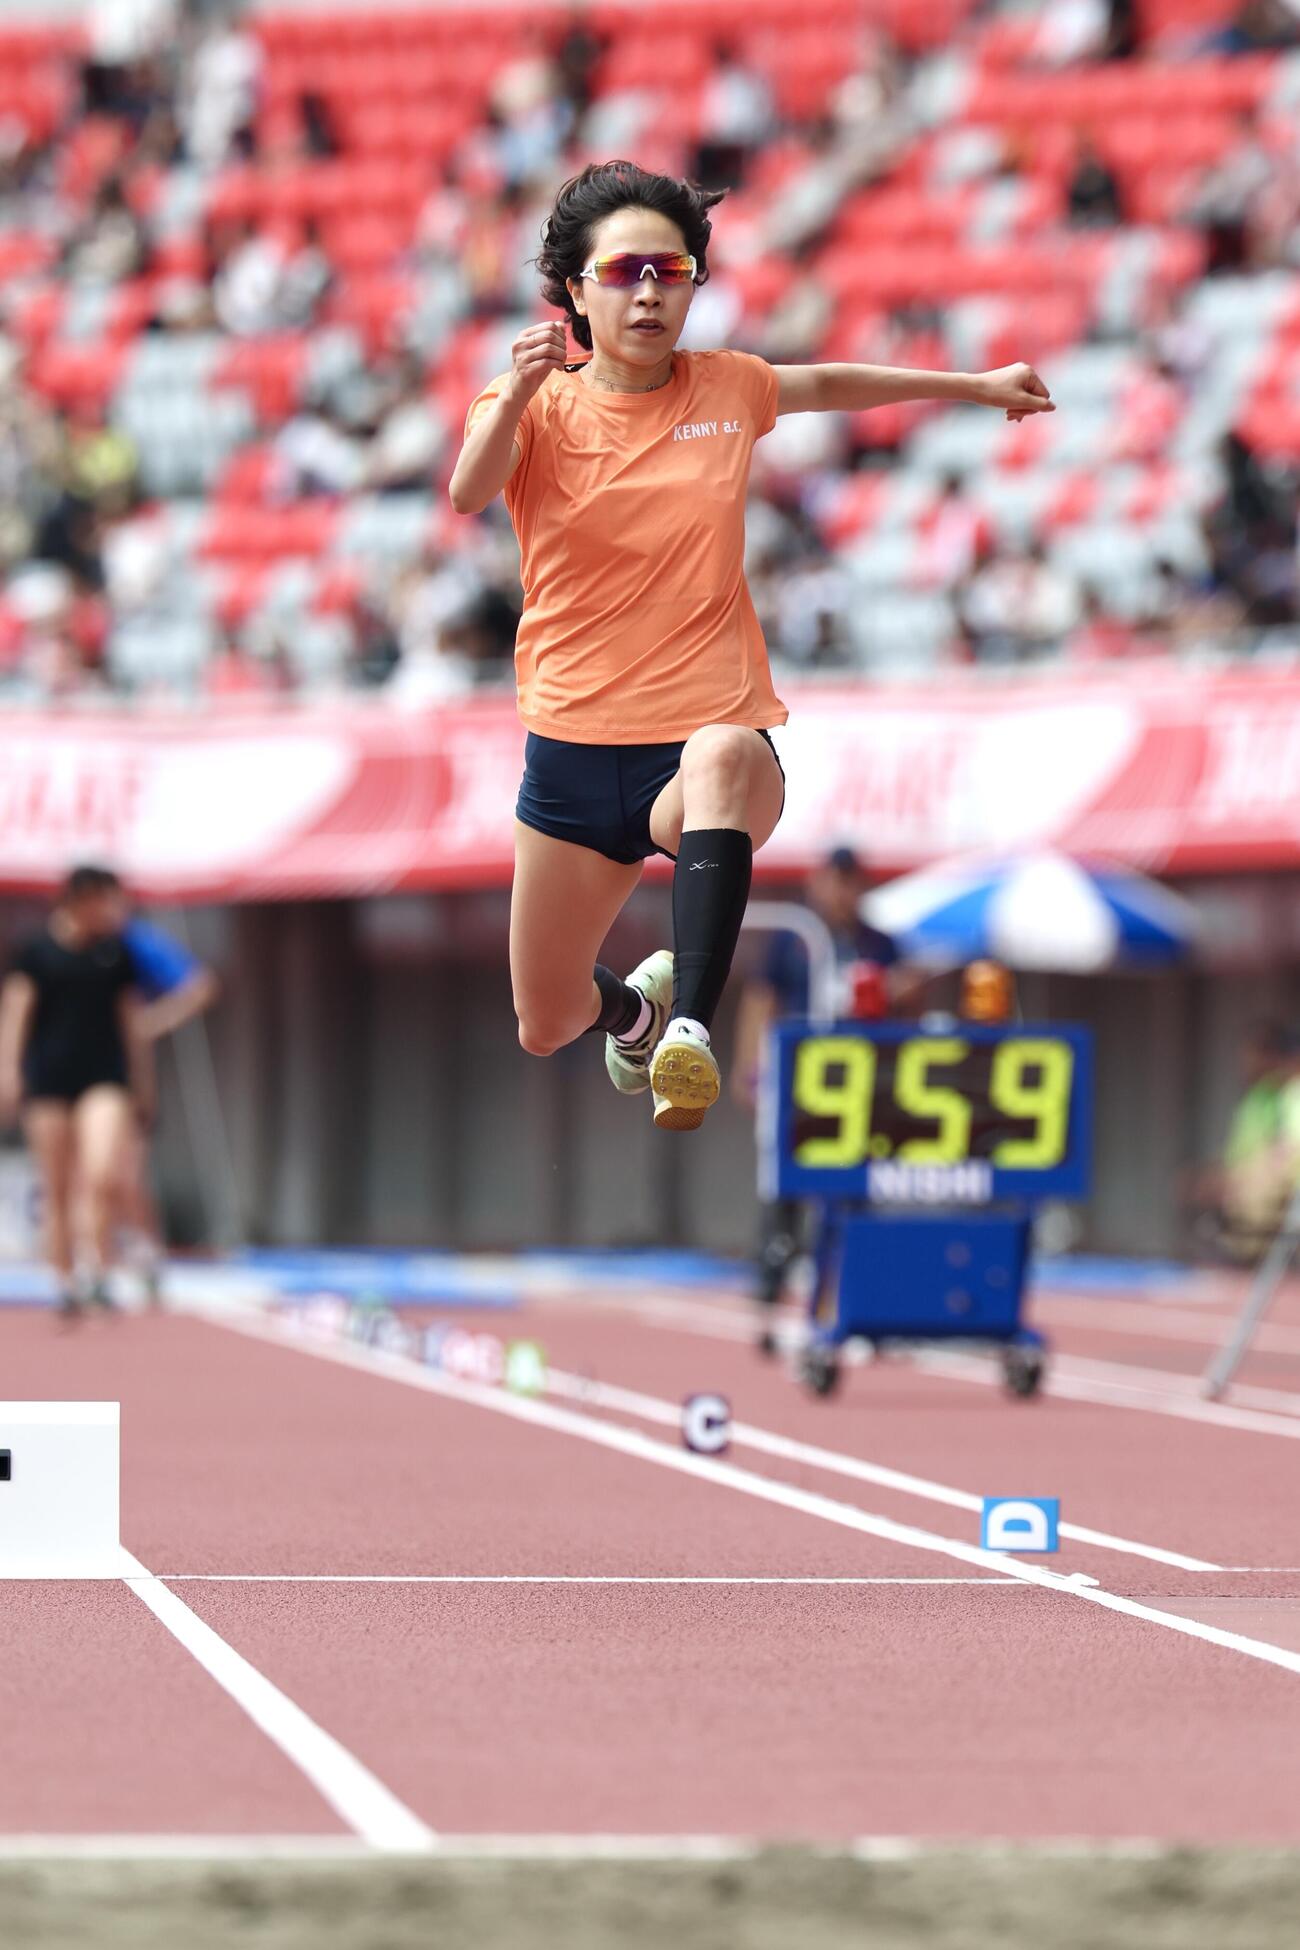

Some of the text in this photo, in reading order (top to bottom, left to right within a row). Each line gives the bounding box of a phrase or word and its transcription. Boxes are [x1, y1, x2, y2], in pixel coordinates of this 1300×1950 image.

[673, 421, 718, 442] KENNY
[793, 1036, 1074, 1169] 9.59
[684, 1395, 729, 1452] C
[986, 1500, 1049, 1551] D
